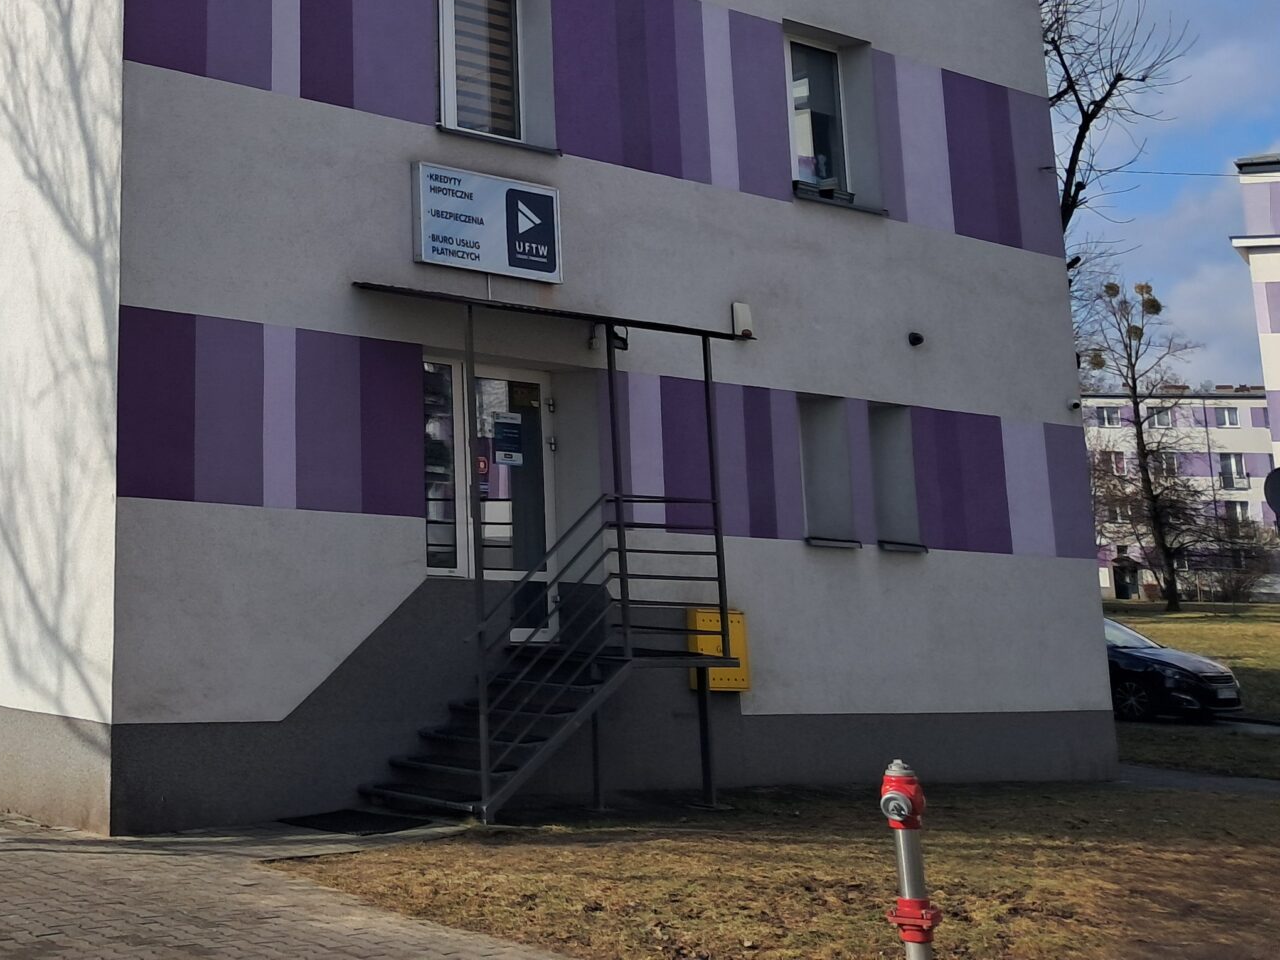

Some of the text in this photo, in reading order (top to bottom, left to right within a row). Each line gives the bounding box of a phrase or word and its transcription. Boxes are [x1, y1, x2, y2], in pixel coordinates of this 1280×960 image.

[429, 173, 462, 187] KREDYTY
[429, 185, 474, 201] HIPOTECZNE
[430, 208, 485, 226] UBEZPIECZENIA
[431, 233, 481, 250] BIURO USŁUG
[515, 240, 548, 257] UFTW
[431, 247, 481, 262] PŁATNICZYCH
